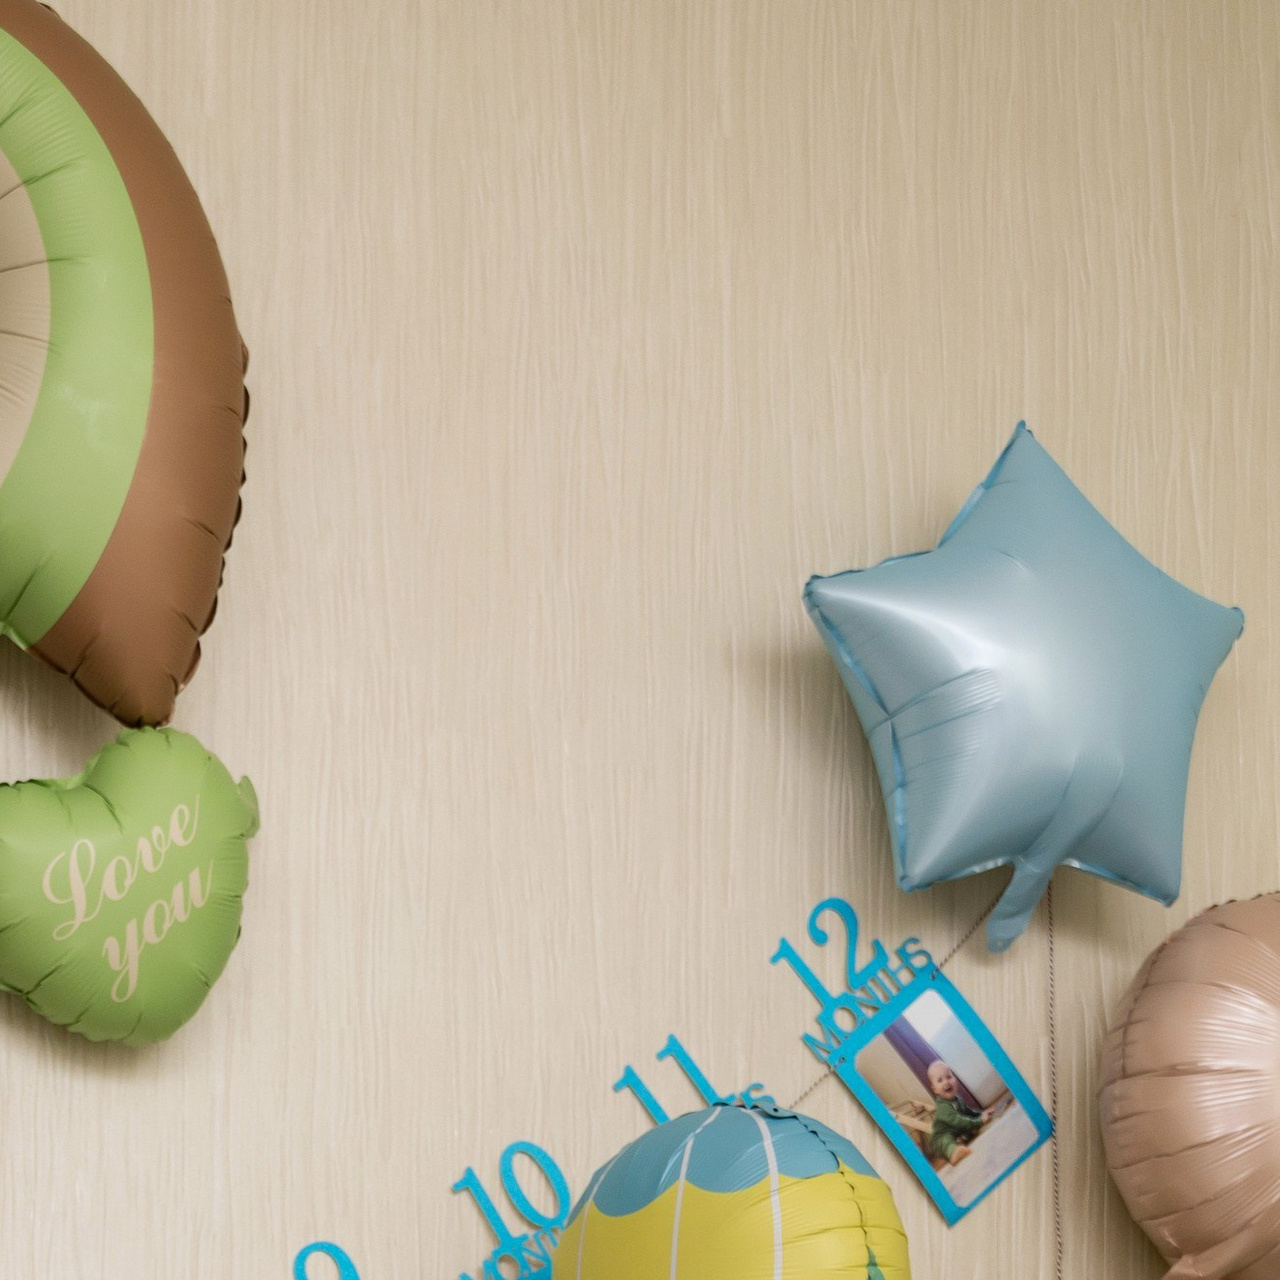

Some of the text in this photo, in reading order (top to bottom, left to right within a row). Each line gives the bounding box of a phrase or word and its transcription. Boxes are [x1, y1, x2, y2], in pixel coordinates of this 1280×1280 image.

[42, 794, 201, 941] Love
[101, 858, 214, 1003] you
[770, 896, 889, 1006] 12
[801, 937, 933, 1063] MONTHS
[613, 1033, 736, 1126] 11
[451, 1140, 571, 1250] 10
